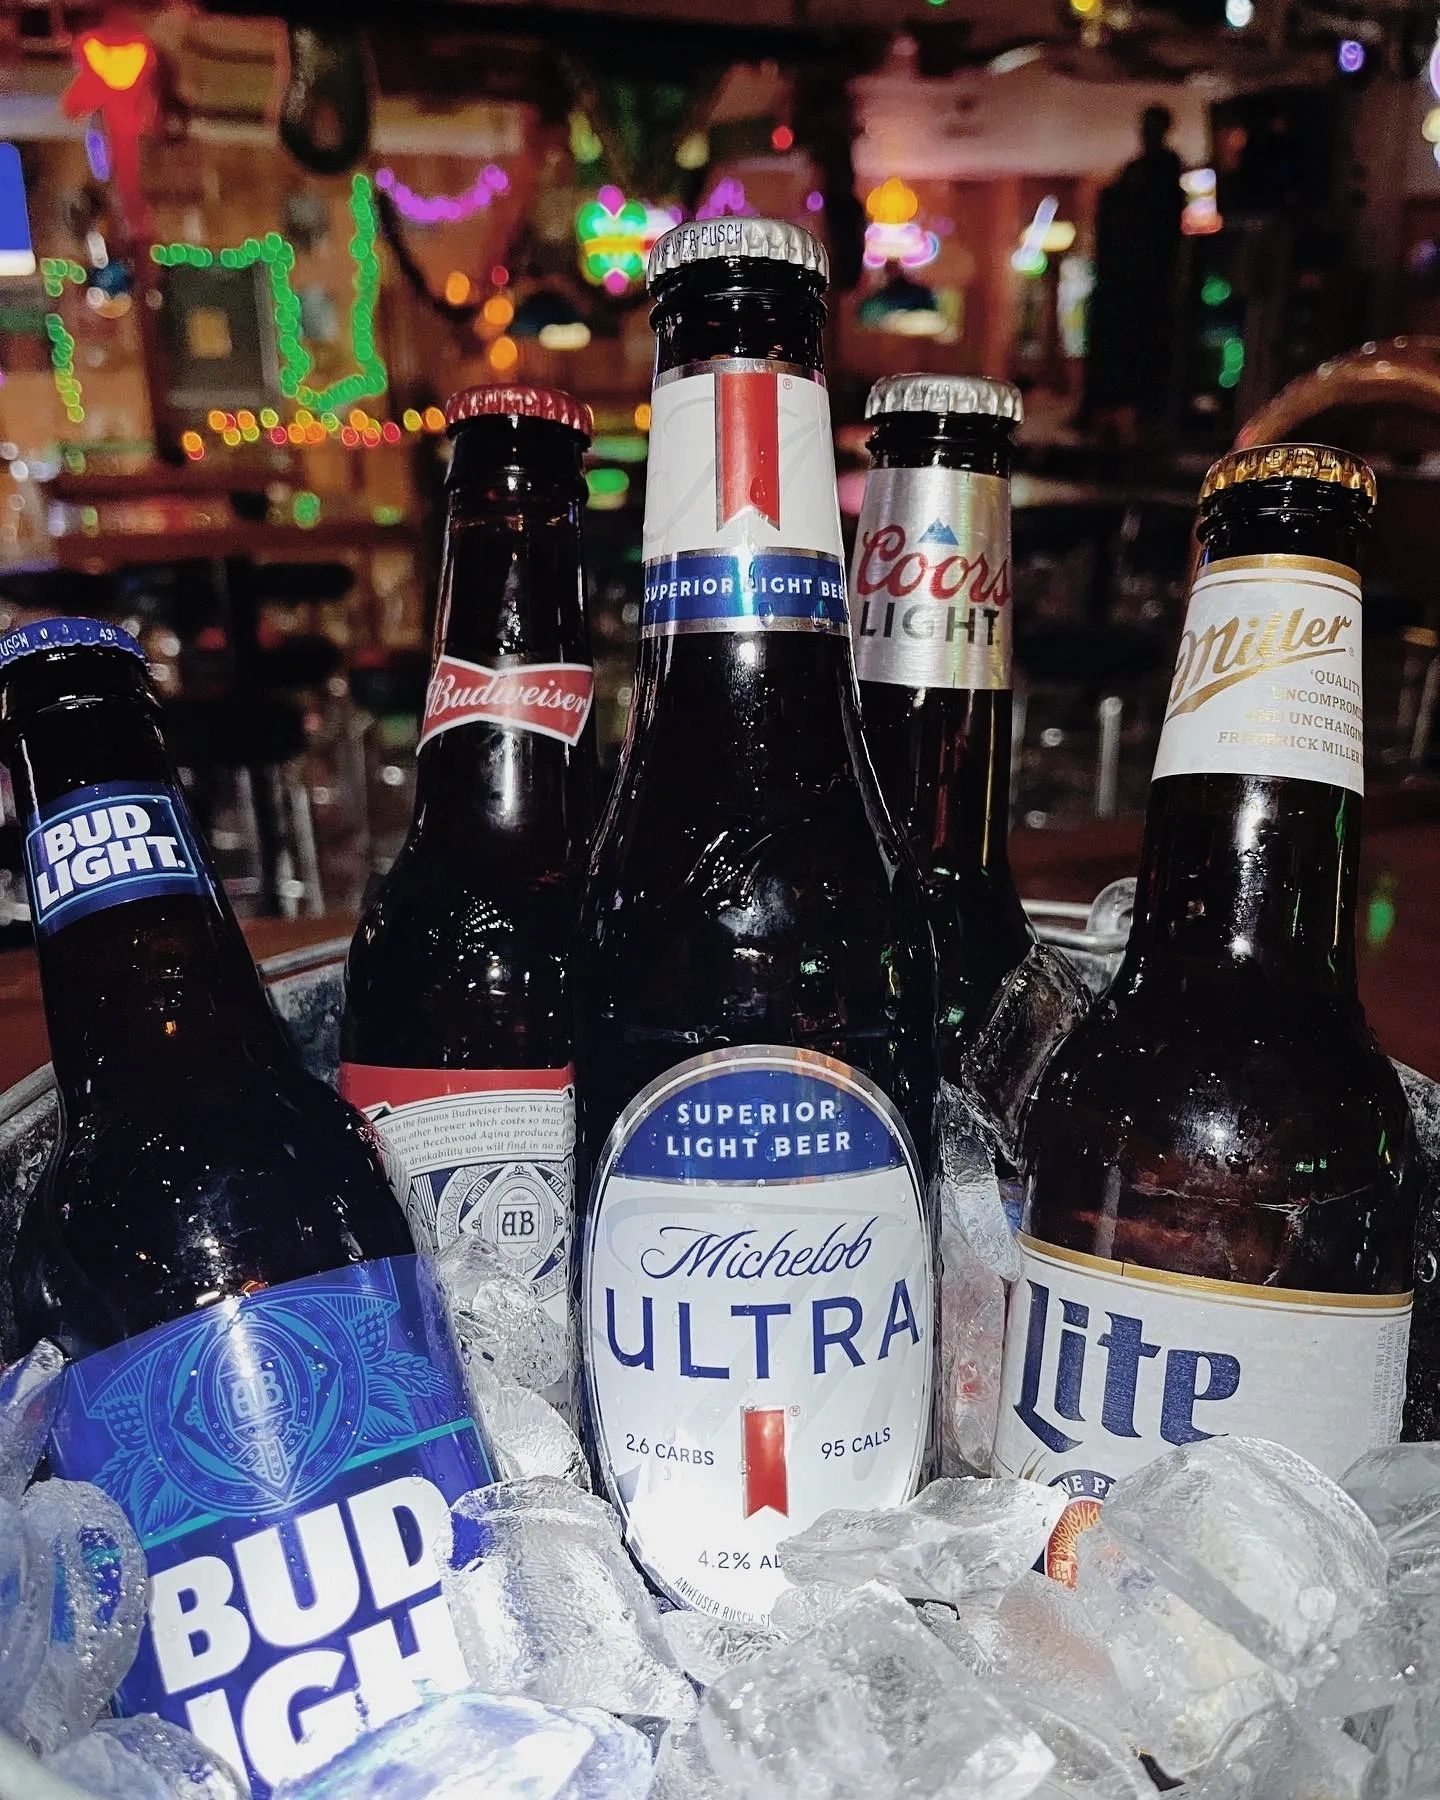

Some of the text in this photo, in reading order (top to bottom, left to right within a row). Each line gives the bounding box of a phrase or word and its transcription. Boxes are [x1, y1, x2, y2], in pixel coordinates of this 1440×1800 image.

[856, 524, 1011, 607] Coors
[644, 577, 734, 603] SUPERIOR
[820, 581, 844, 600] BEE
[860, 601, 1000, 646] LIGHT
[1169, 607, 1353, 705] Miller
[426, 673, 588, 719] Budweiser
[1288, 711, 1362, 742] UNCHANGIN
[43, 804, 152, 864] BUD
[403, 1120, 416, 1128] the
[417, 1113, 449, 1127] famous
[452, 1105, 503, 1119] Budweiser
[505, 1104, 527, 1113] beer.
[529, 1104, 543, 1113] We
[545, 1103, 563, 1113] kno
[409, 1128, 432, 1140] other
[434, 1121, 466, 1133] brewer
[469, 1117, 498, 1128] which
[500, 1117, 525, 1125] costs
[676, 1099, 836, 1126] SUPERIOR
[409, 1146, 463, 1166] drinkability
[466, 1145, 484, 1155] you
[486, 1141, 504, 1151] will
[507, 1140, 527, 1151] find
[423, 1131, 477, 1148] Beechwood
[480, 1130, 510, 1140] Aging
[513, 1128, 559, 1138] produces
[666, 1131, 852, 1159] LIGHT BEER
[465, 1178, 491, 1206] UNITED
[501, 1210, 535, 1237] AB
[640, 1215, 880, 1280] Michelob
[605, 1278, 922, 1380] ULTRA
[1012, 1279, 1242, 1454] Lite
[625, 1433, 715, 1466] 2.6 CARBS
[820, 1427, 892, 1460] 95 CALS
[697, 1551, 783, 1570] 4.2% AL
[150, 1475, 452, 1695] BUD
[184, 1593, 474, 1799] IGH
